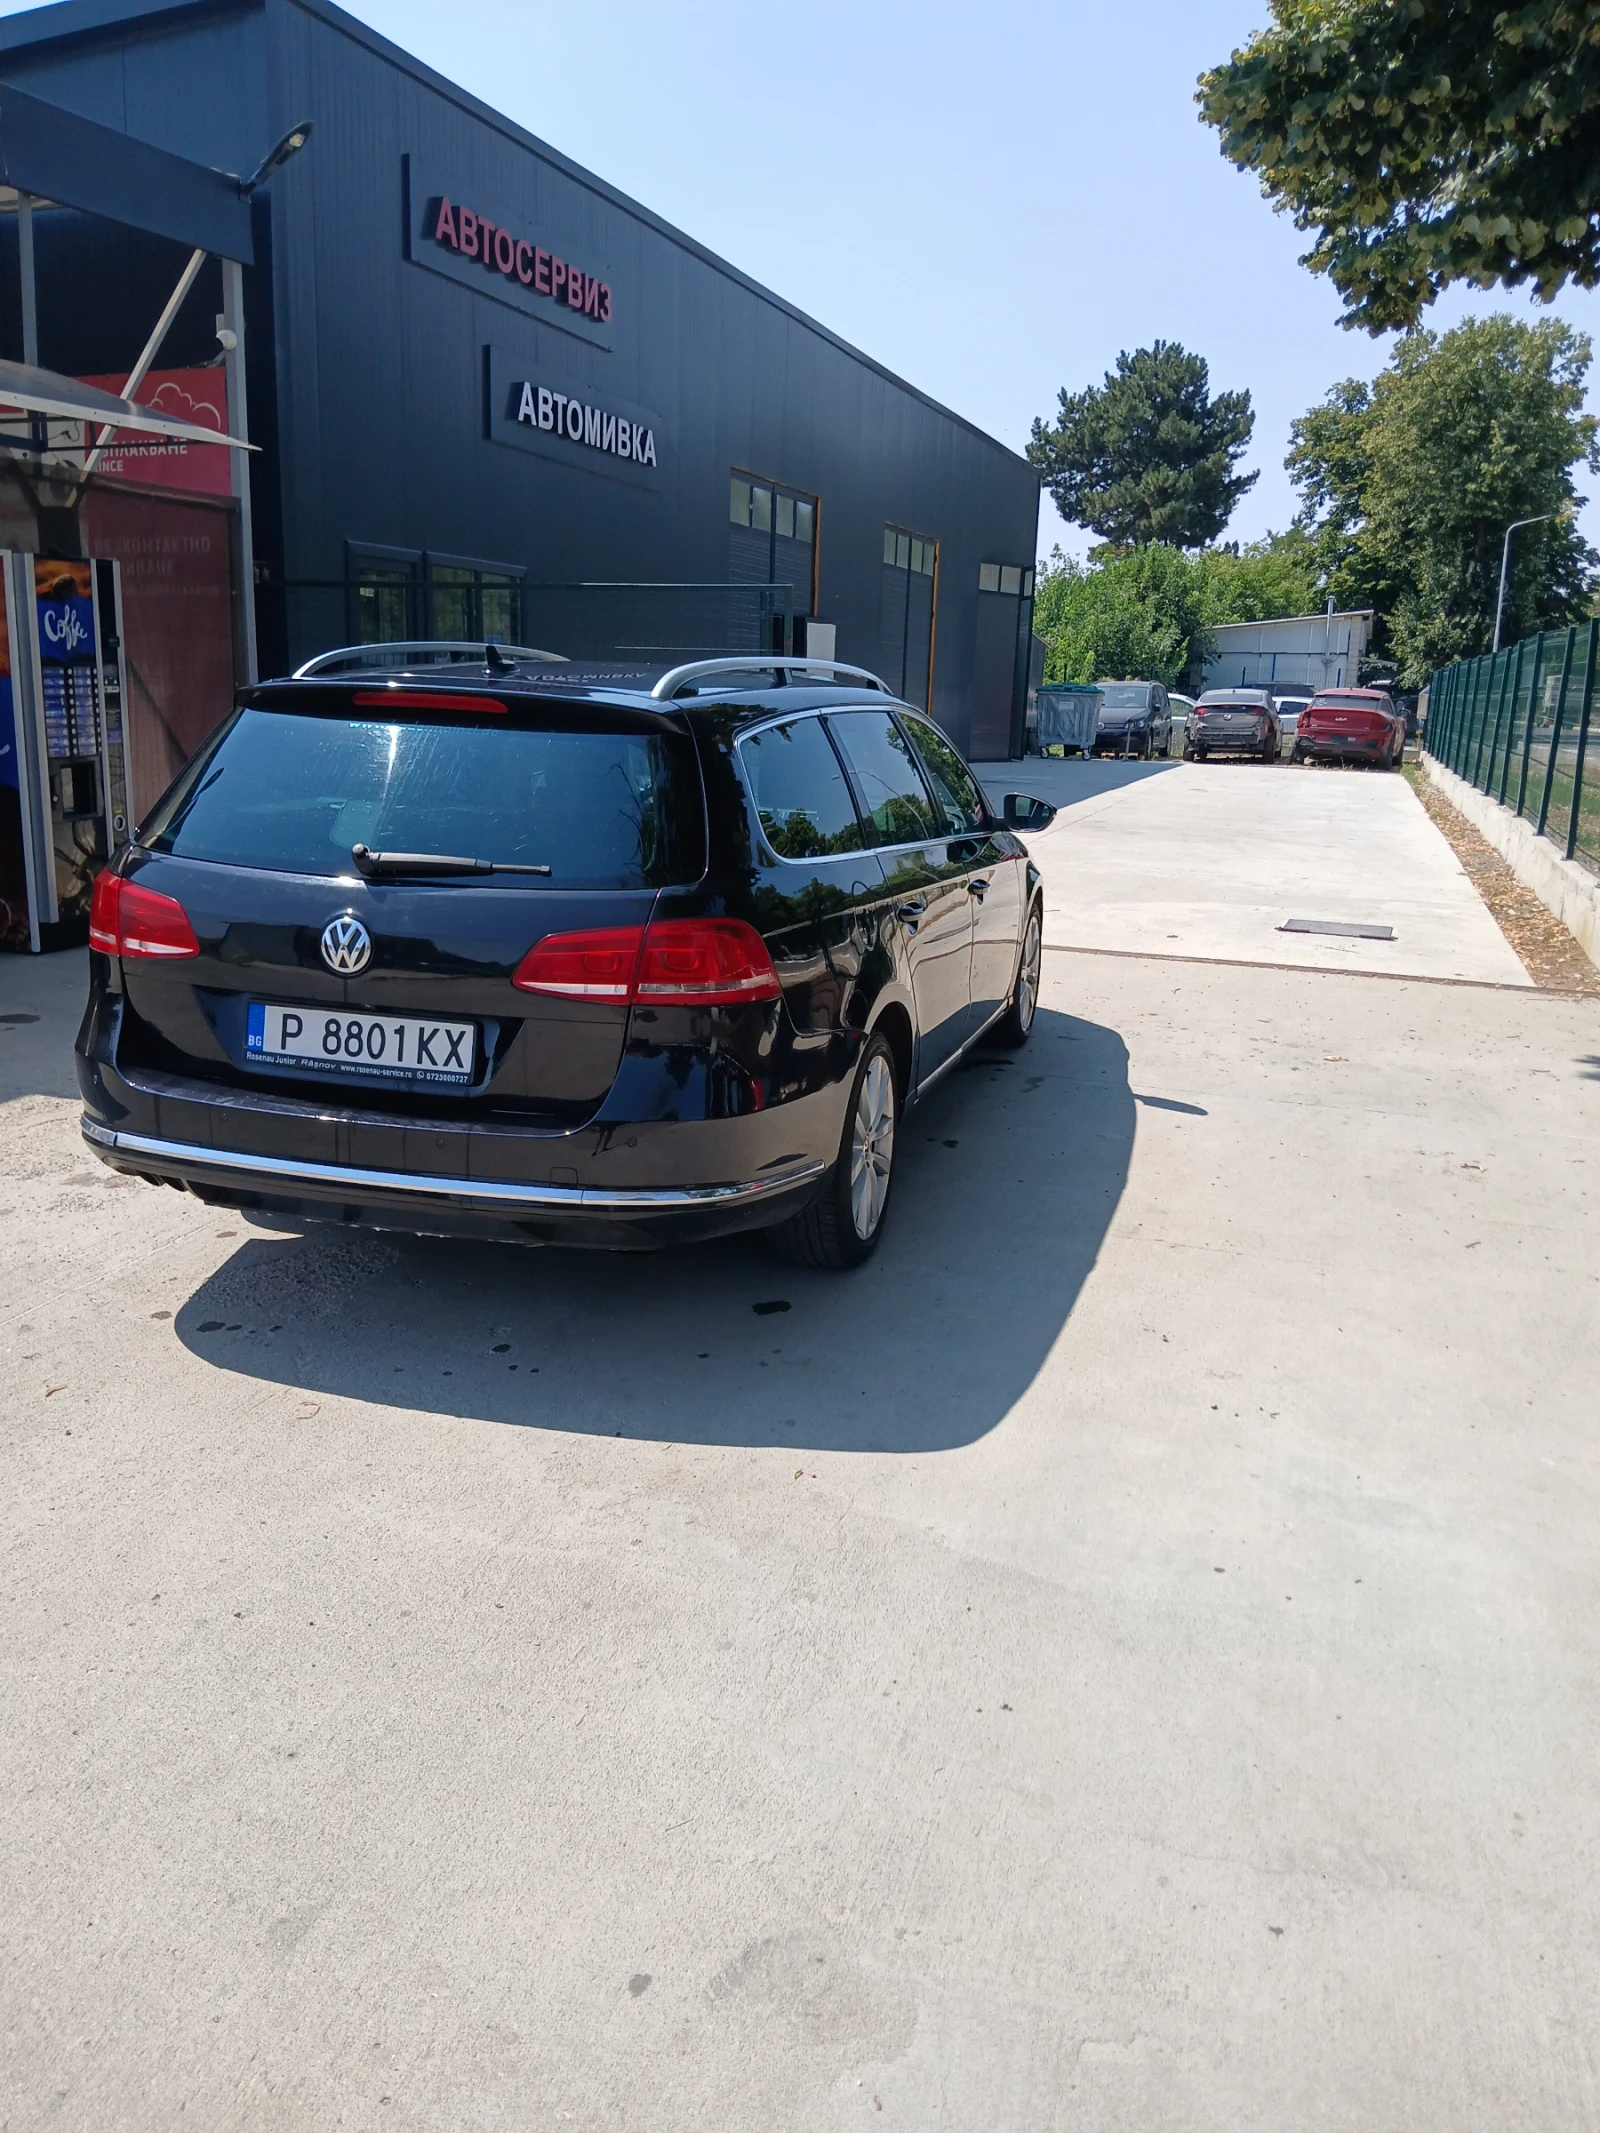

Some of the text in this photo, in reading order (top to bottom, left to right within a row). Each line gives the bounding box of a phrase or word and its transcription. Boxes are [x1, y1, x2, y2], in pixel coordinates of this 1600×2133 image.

[436, 196, 612, 323] АВТОСЕРВИЗ
[517, 381, 658, 468] АВТОМИВКА
[96, 460, 124, 472] INCE
[44, 604, 88, 650] Coffee
[248, 1034, 262, 1047] BG
[280, 1013, 303, 1051] P
[246, 1051, 275, 1063] Rosenau
[275, 1056, 297, 1066] Junior
[340, 1064, 413, 1078] www.rosenau-service.ro
